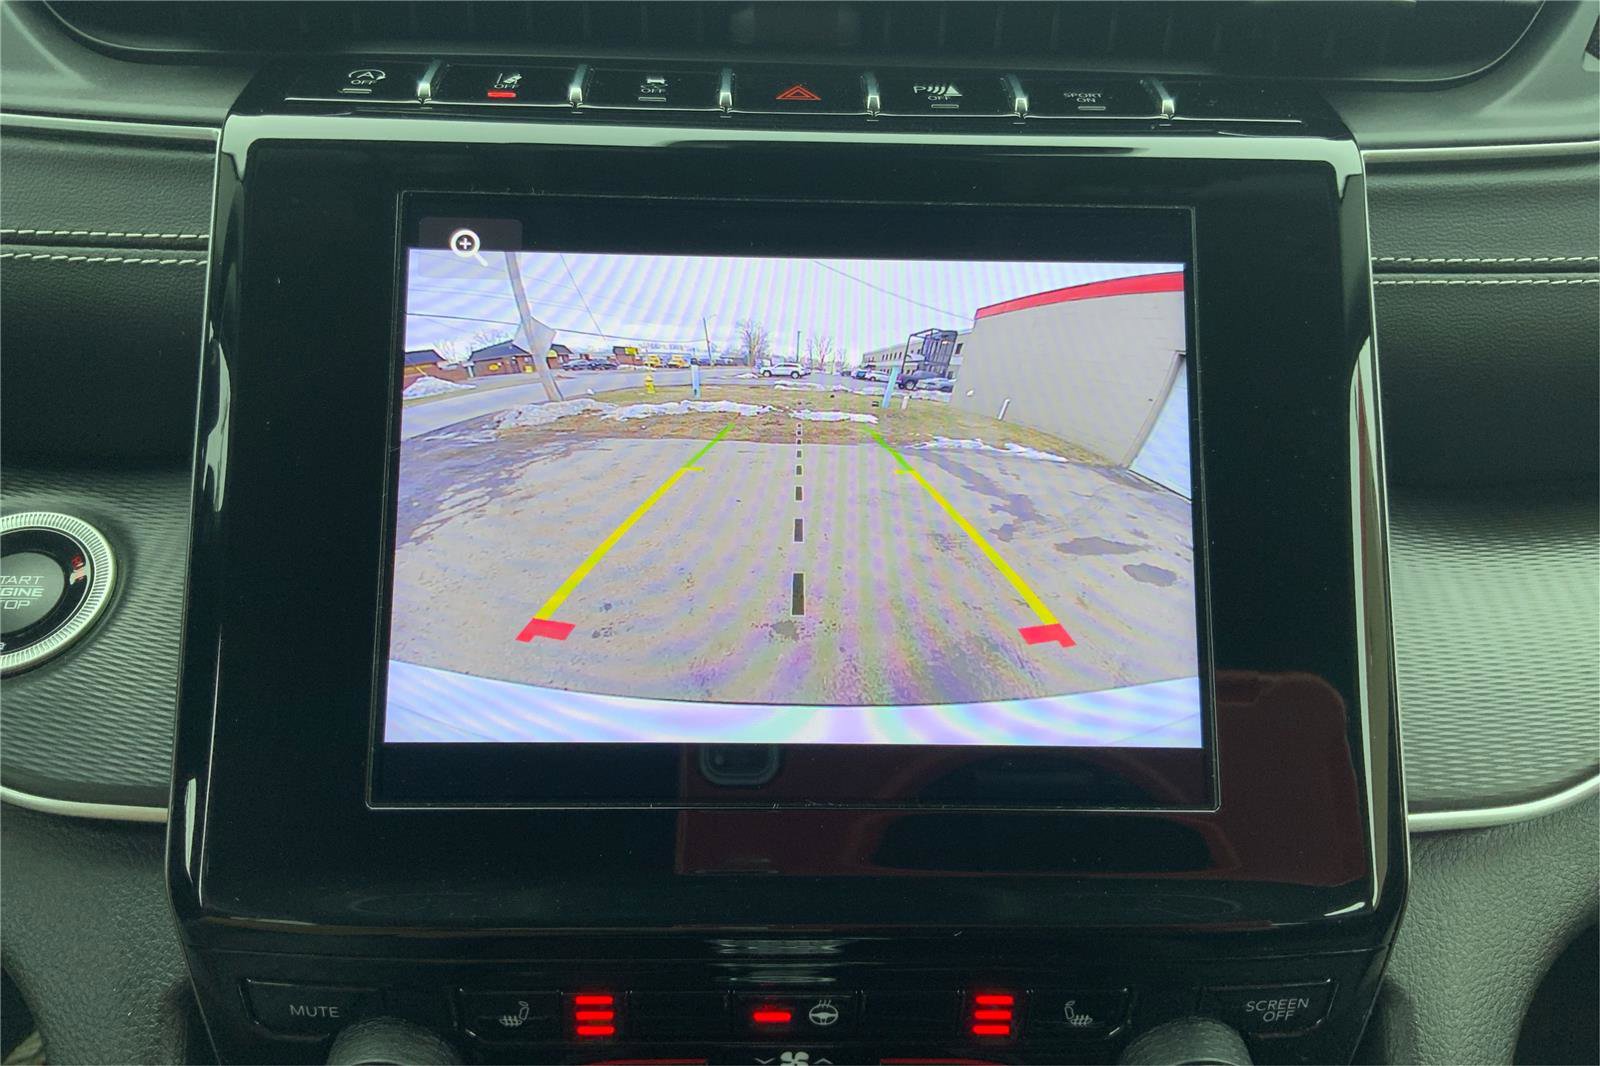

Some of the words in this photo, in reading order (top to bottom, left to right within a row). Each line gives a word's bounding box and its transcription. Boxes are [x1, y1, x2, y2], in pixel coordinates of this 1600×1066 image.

[289, 1004, 341, 1018] MUTE
[1245, 998, 1310, 1013] SCREEN
[1262, 1010, 1296, 1023] OFF
